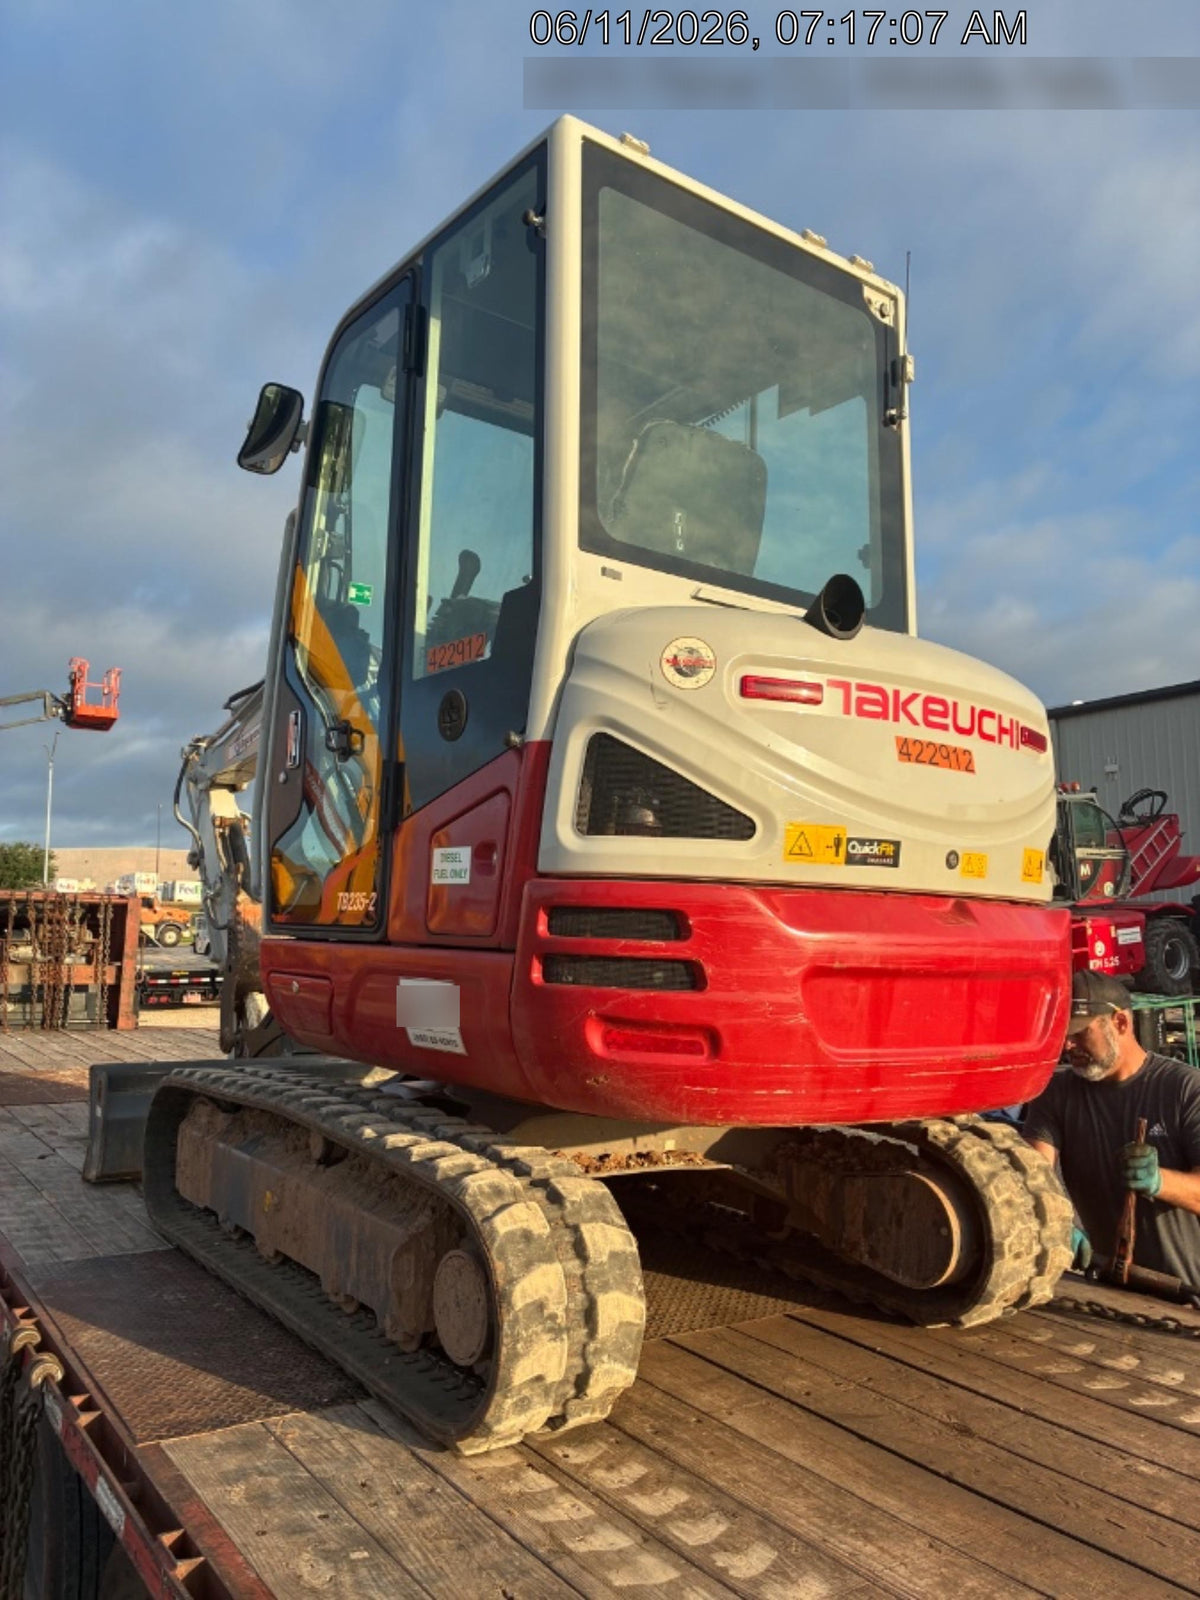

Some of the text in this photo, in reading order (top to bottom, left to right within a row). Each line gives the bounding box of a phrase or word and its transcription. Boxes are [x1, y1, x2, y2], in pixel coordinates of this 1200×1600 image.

[428, 634, 485, 671] 422912
[899, 738, 975, 774] 422912
[450, 868, 468, 879] ONLY
